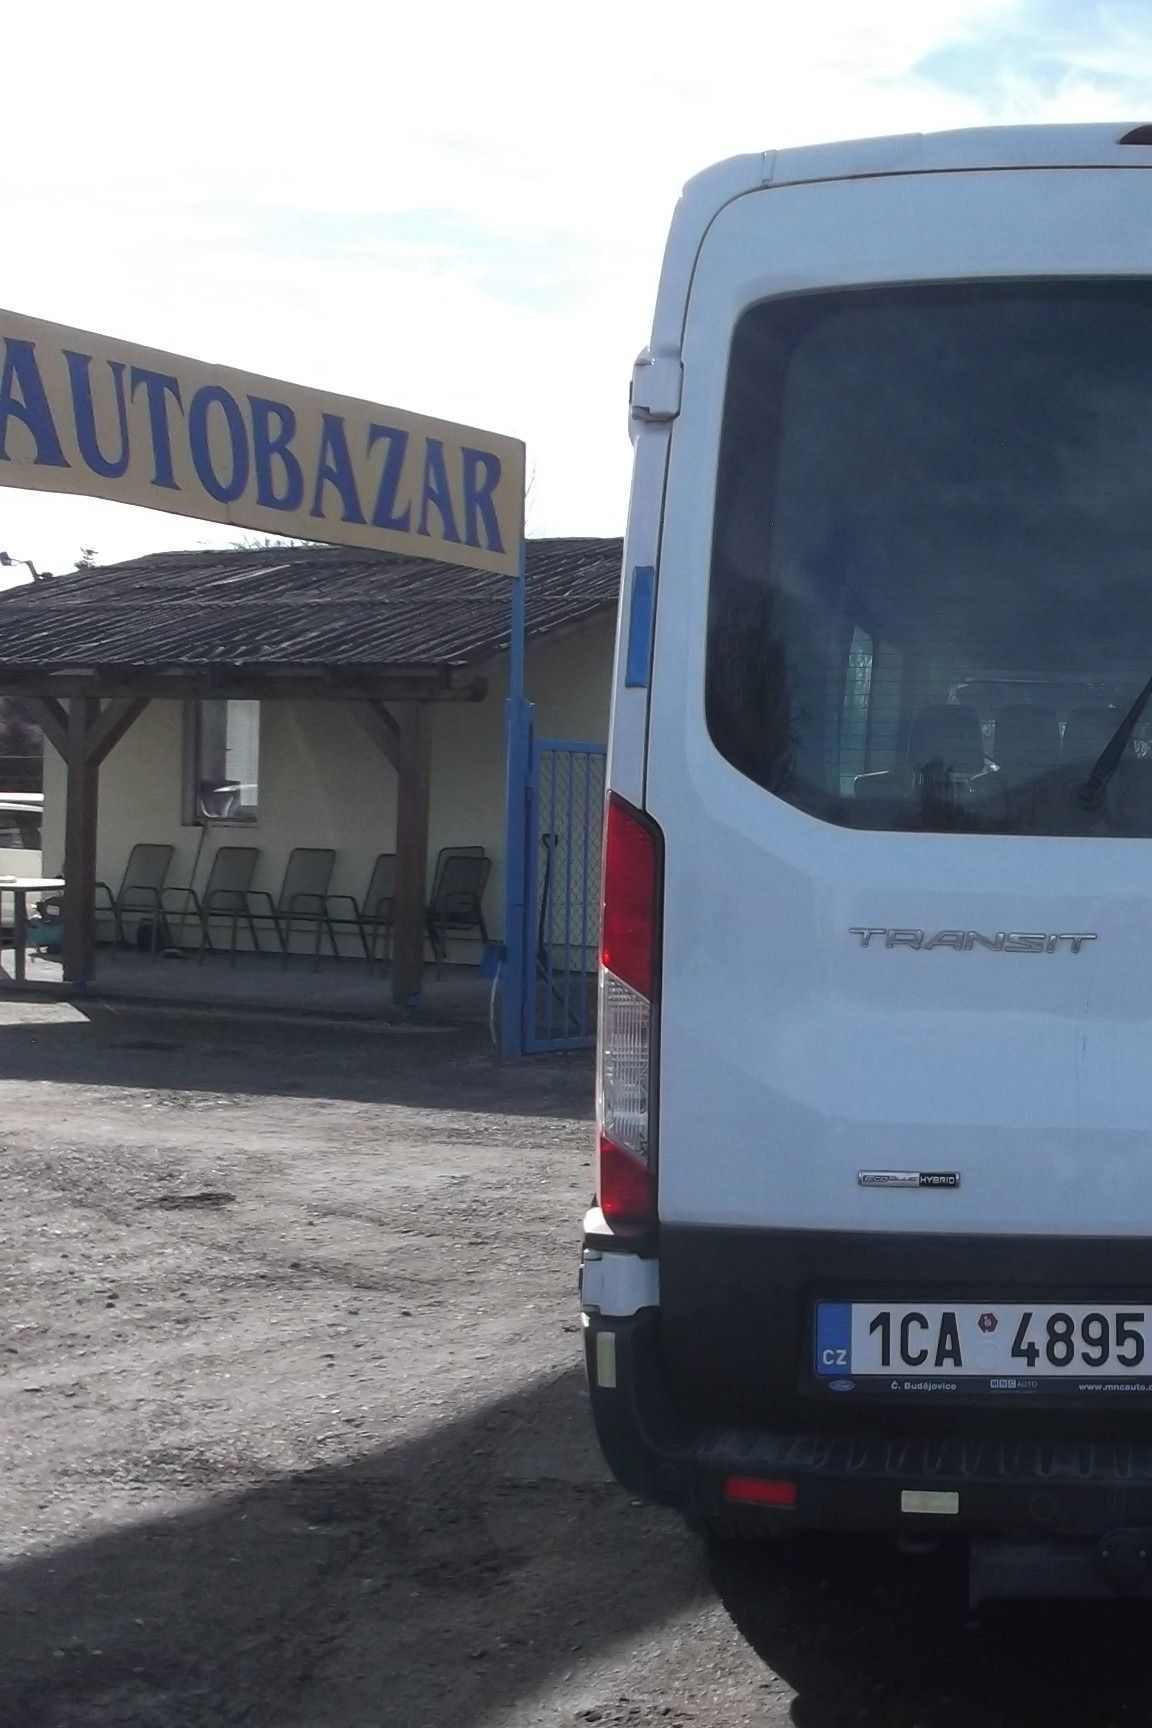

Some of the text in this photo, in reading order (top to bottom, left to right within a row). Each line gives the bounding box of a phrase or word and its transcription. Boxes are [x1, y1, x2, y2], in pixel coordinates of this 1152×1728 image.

[0, 337, 506, 555] AUTOBAZAR
[848, 928, 1097, 954] TRANSIT
[919, 1176, 956, 1185] HYBRID
[869, 1311, 1145, 1367] 1CA 4895
[822, 1350, 847, 1365] CZ
[904, 1381, 958, 1391] Budějovice
